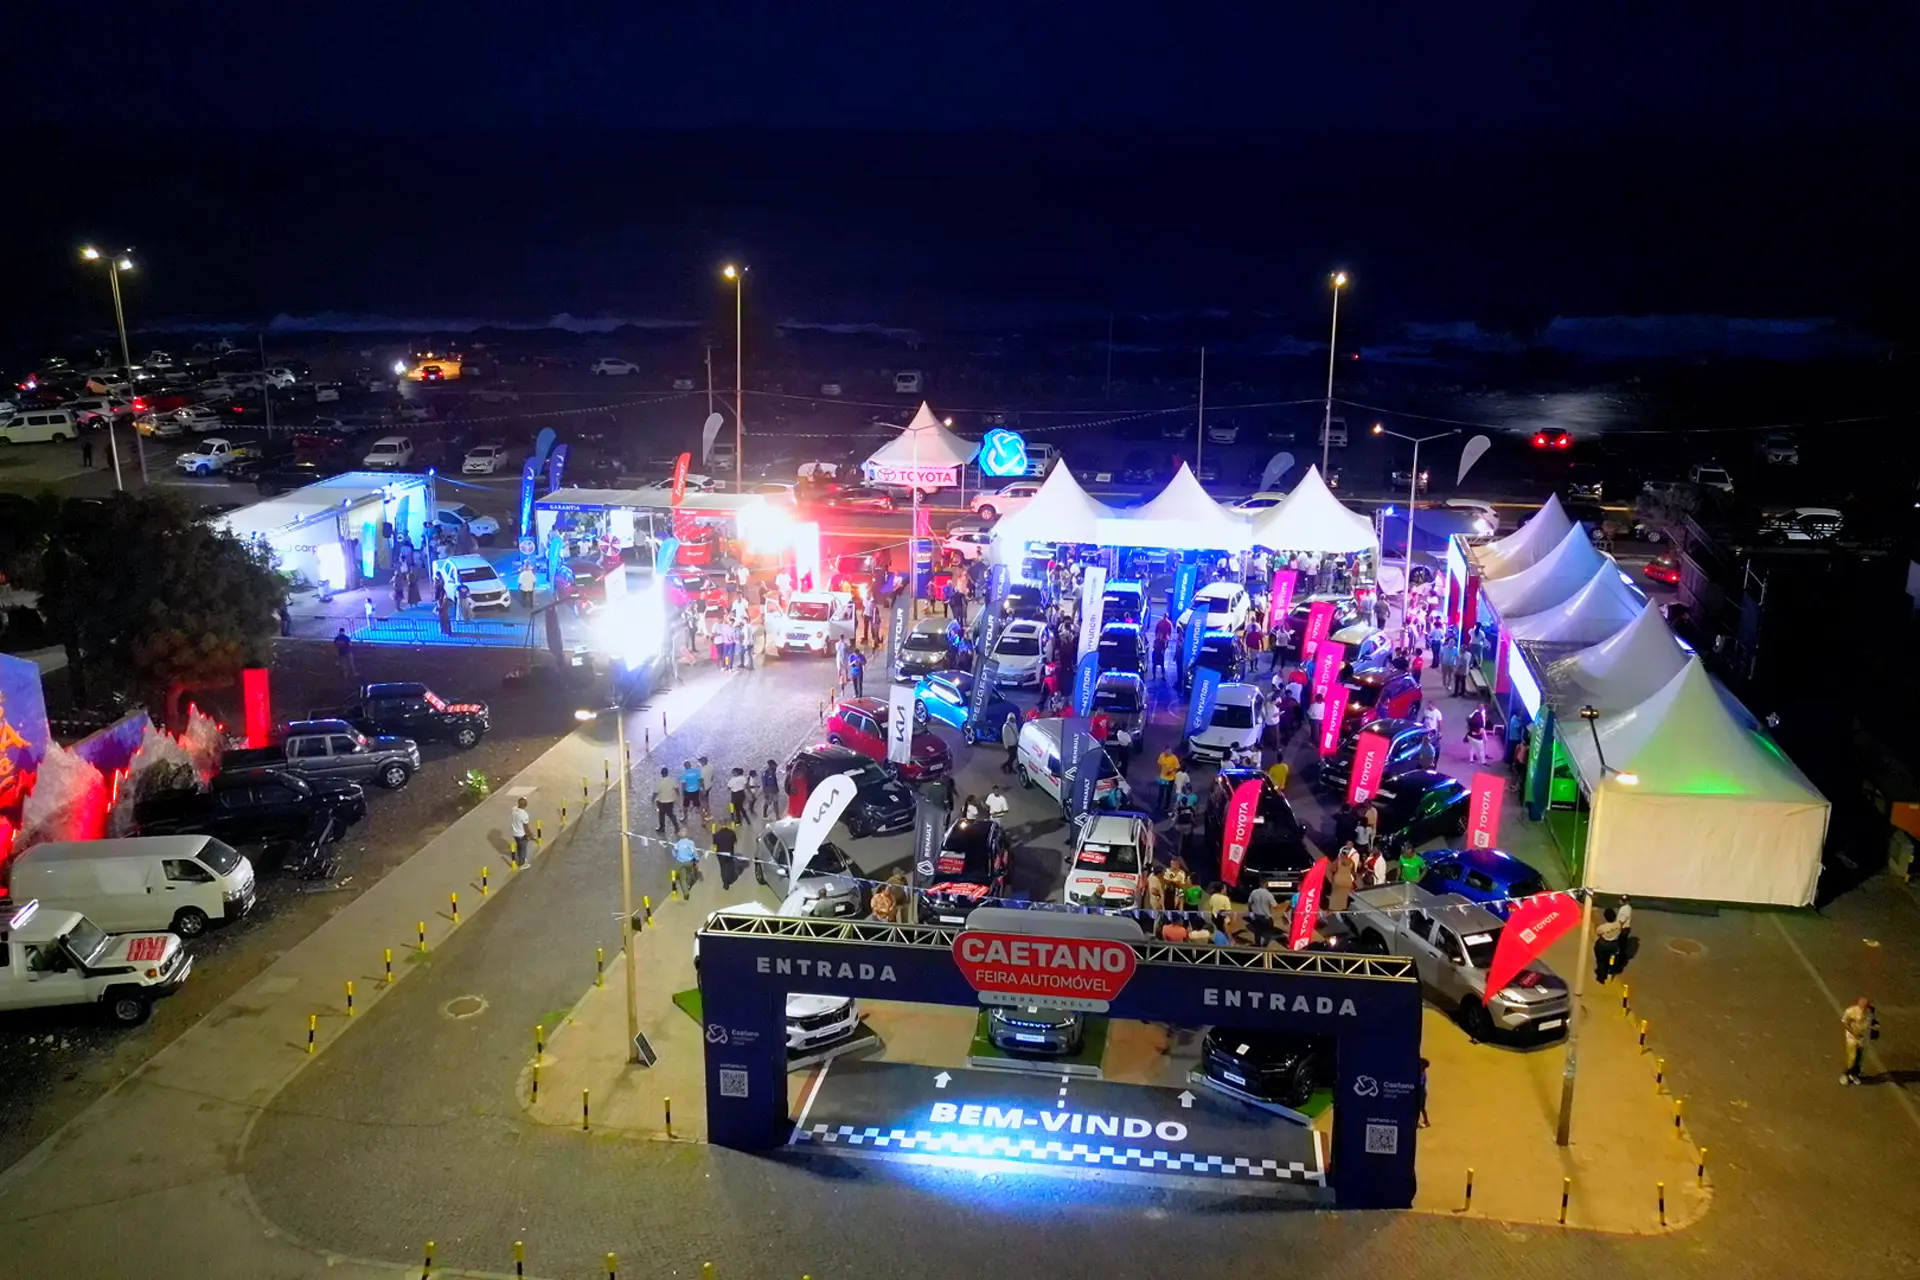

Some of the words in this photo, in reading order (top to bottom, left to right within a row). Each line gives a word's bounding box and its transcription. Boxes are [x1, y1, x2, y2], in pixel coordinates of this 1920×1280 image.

[900, 471, 953, 482] TOYOTA
[1180, 573, 1189, 601] HYUNDAI
[1278, 582, 1288, 608] TOYOTA
[1192, 619, 1202, 656] HYUNDAI
[1312, 613, 1324, 640] TOYOTA
[1322, 654, 1333, 683] TOYOTA
[1082, 667, 1091, 708] HYUNDAI
[1197, 679, 1210, 716] HYUNDAI
[1330, 700, 1340, 731] TOYOTA
[1360, 751, 1375, 786] TOYOTA
[1236, 802, 1249, 841] TOYOTA
[1479, 791, 1492, 828] TOYOTA
[923, 822, 933, 858] RENAULT
[1300, 888, 1316, 936] TOYOTA
[1533, 911, 1560, 933] TOYOTA
[756, 957, 897, 983] ENTRADA
[962, 938, 1126, 972] CAETANO
[975, 969, 1018, 985] FEIRA
[1020, 974, 1112, 992] AUTOMÓVEL
[1203, 988, 1357, 1016] ENTRADA
[1383, 1081, 1415, 1090] Caetano
[929, 1102, 1188, 1141] BEM-VINDO
